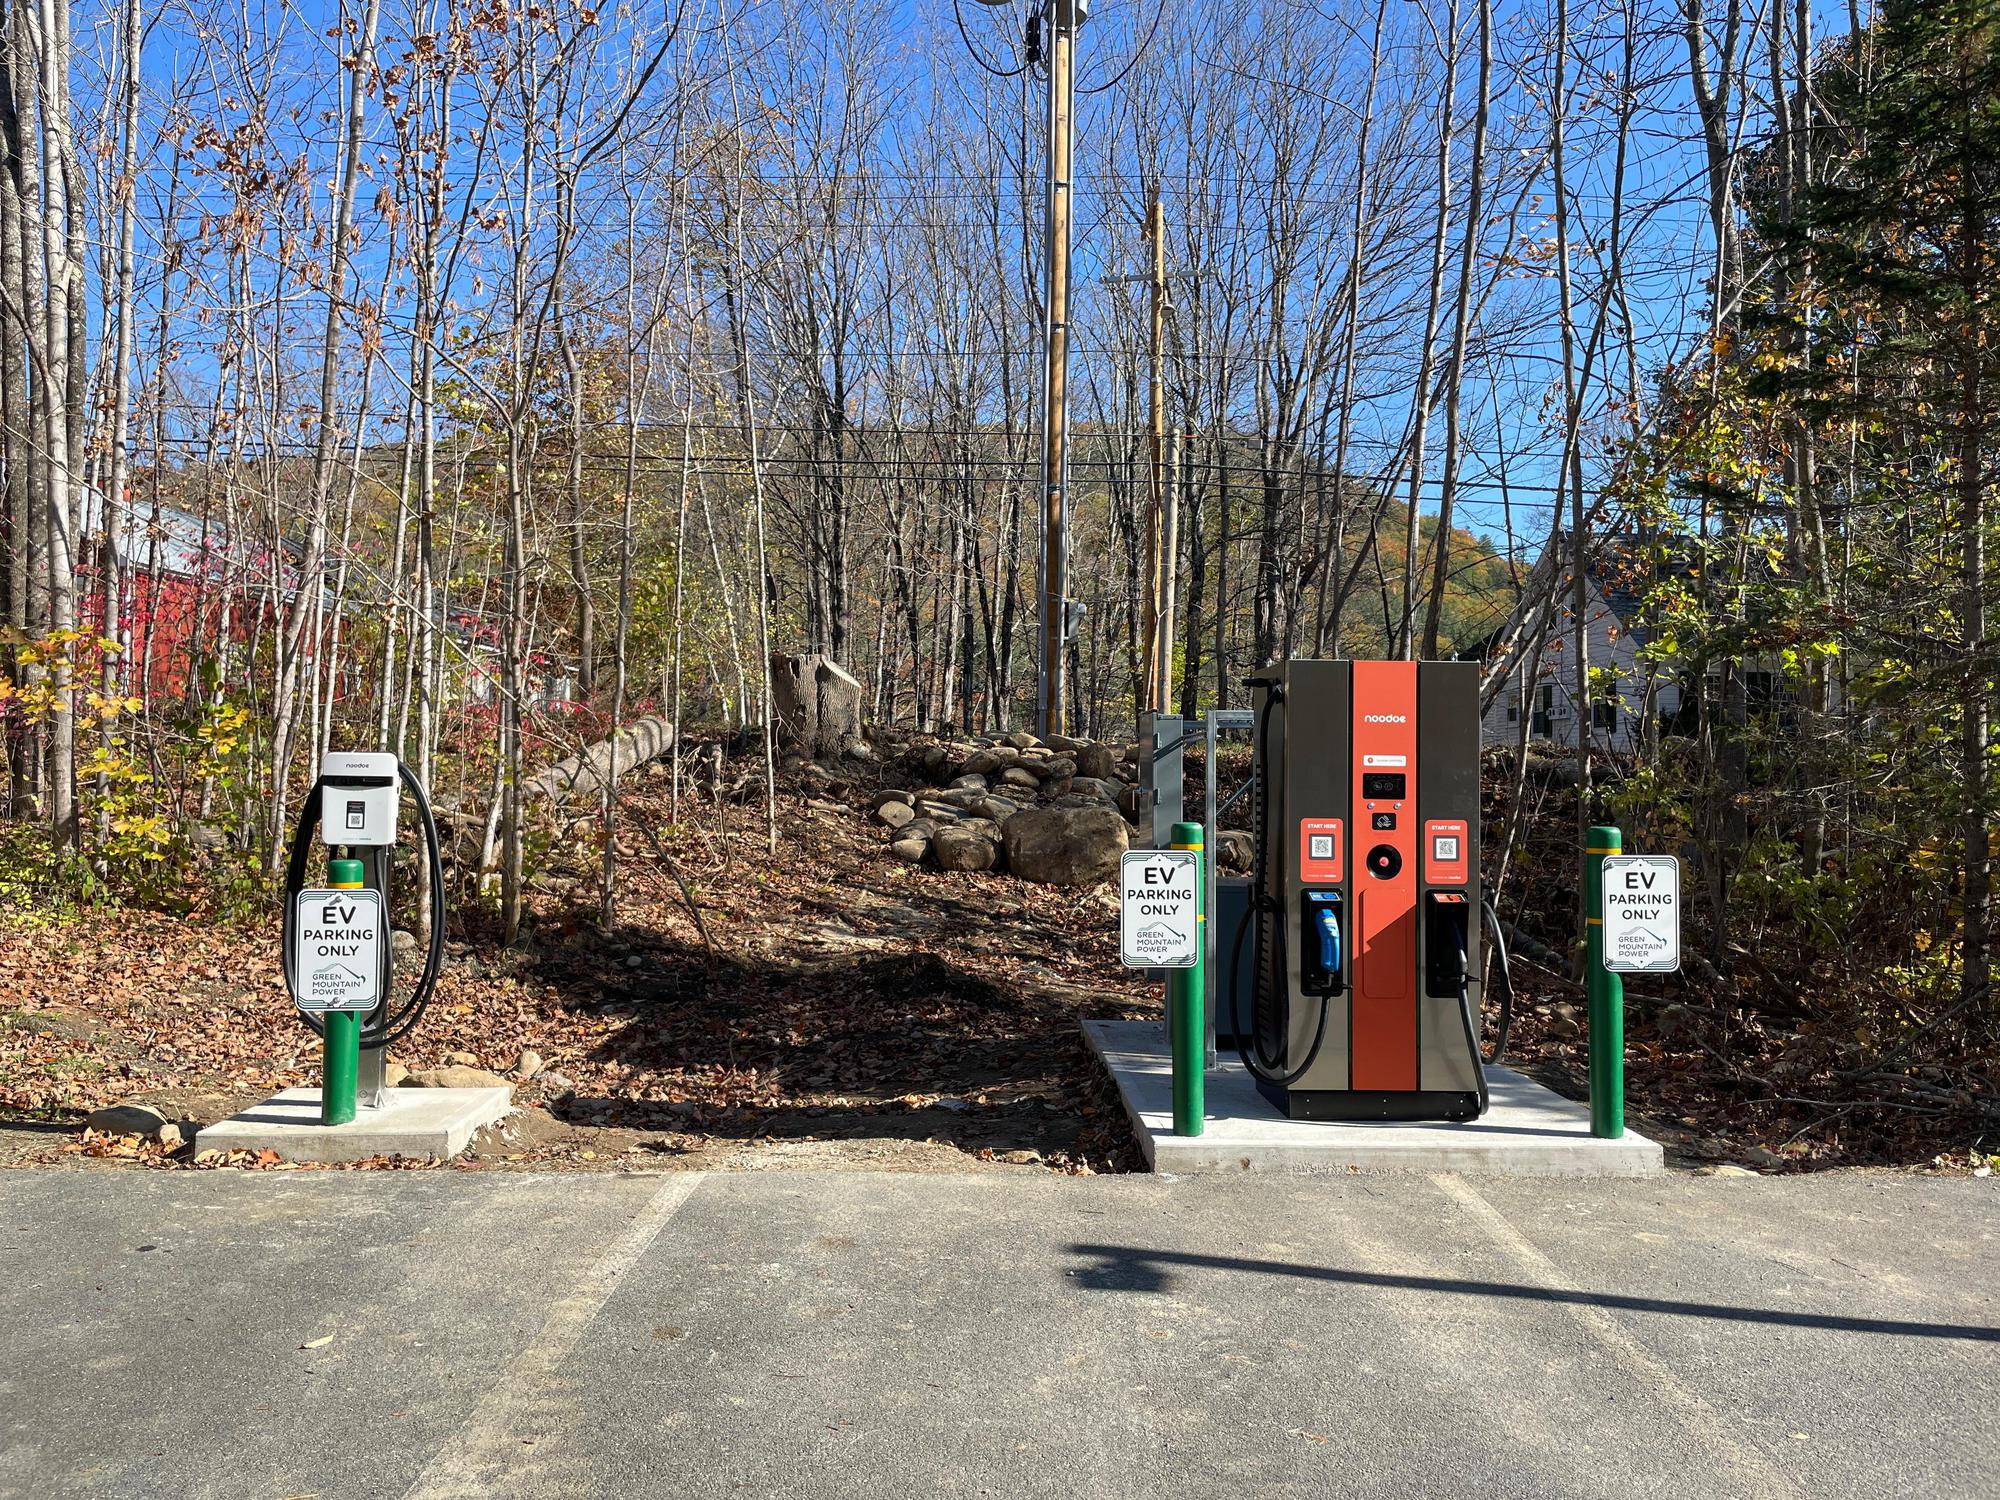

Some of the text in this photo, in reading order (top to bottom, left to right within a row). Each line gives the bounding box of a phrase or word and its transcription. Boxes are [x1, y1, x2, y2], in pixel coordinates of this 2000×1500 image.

[1364, 714, 1406, 723] noodoe
[1144, 866, 1175, 884] EV
[1625, 872, 1656, 889] EV
[1127, 889, 1192, 900] PARKING
[1609, 894, 1672, 904] PARKING
[322, 906, 356, 924] EV
[1140, 904, 1179, 915] ONLY
[1622, 909, 1660, 920] ONLY
[303, 929, 373, 940] PARKING
[317, 945, 359, 956] ONLY
